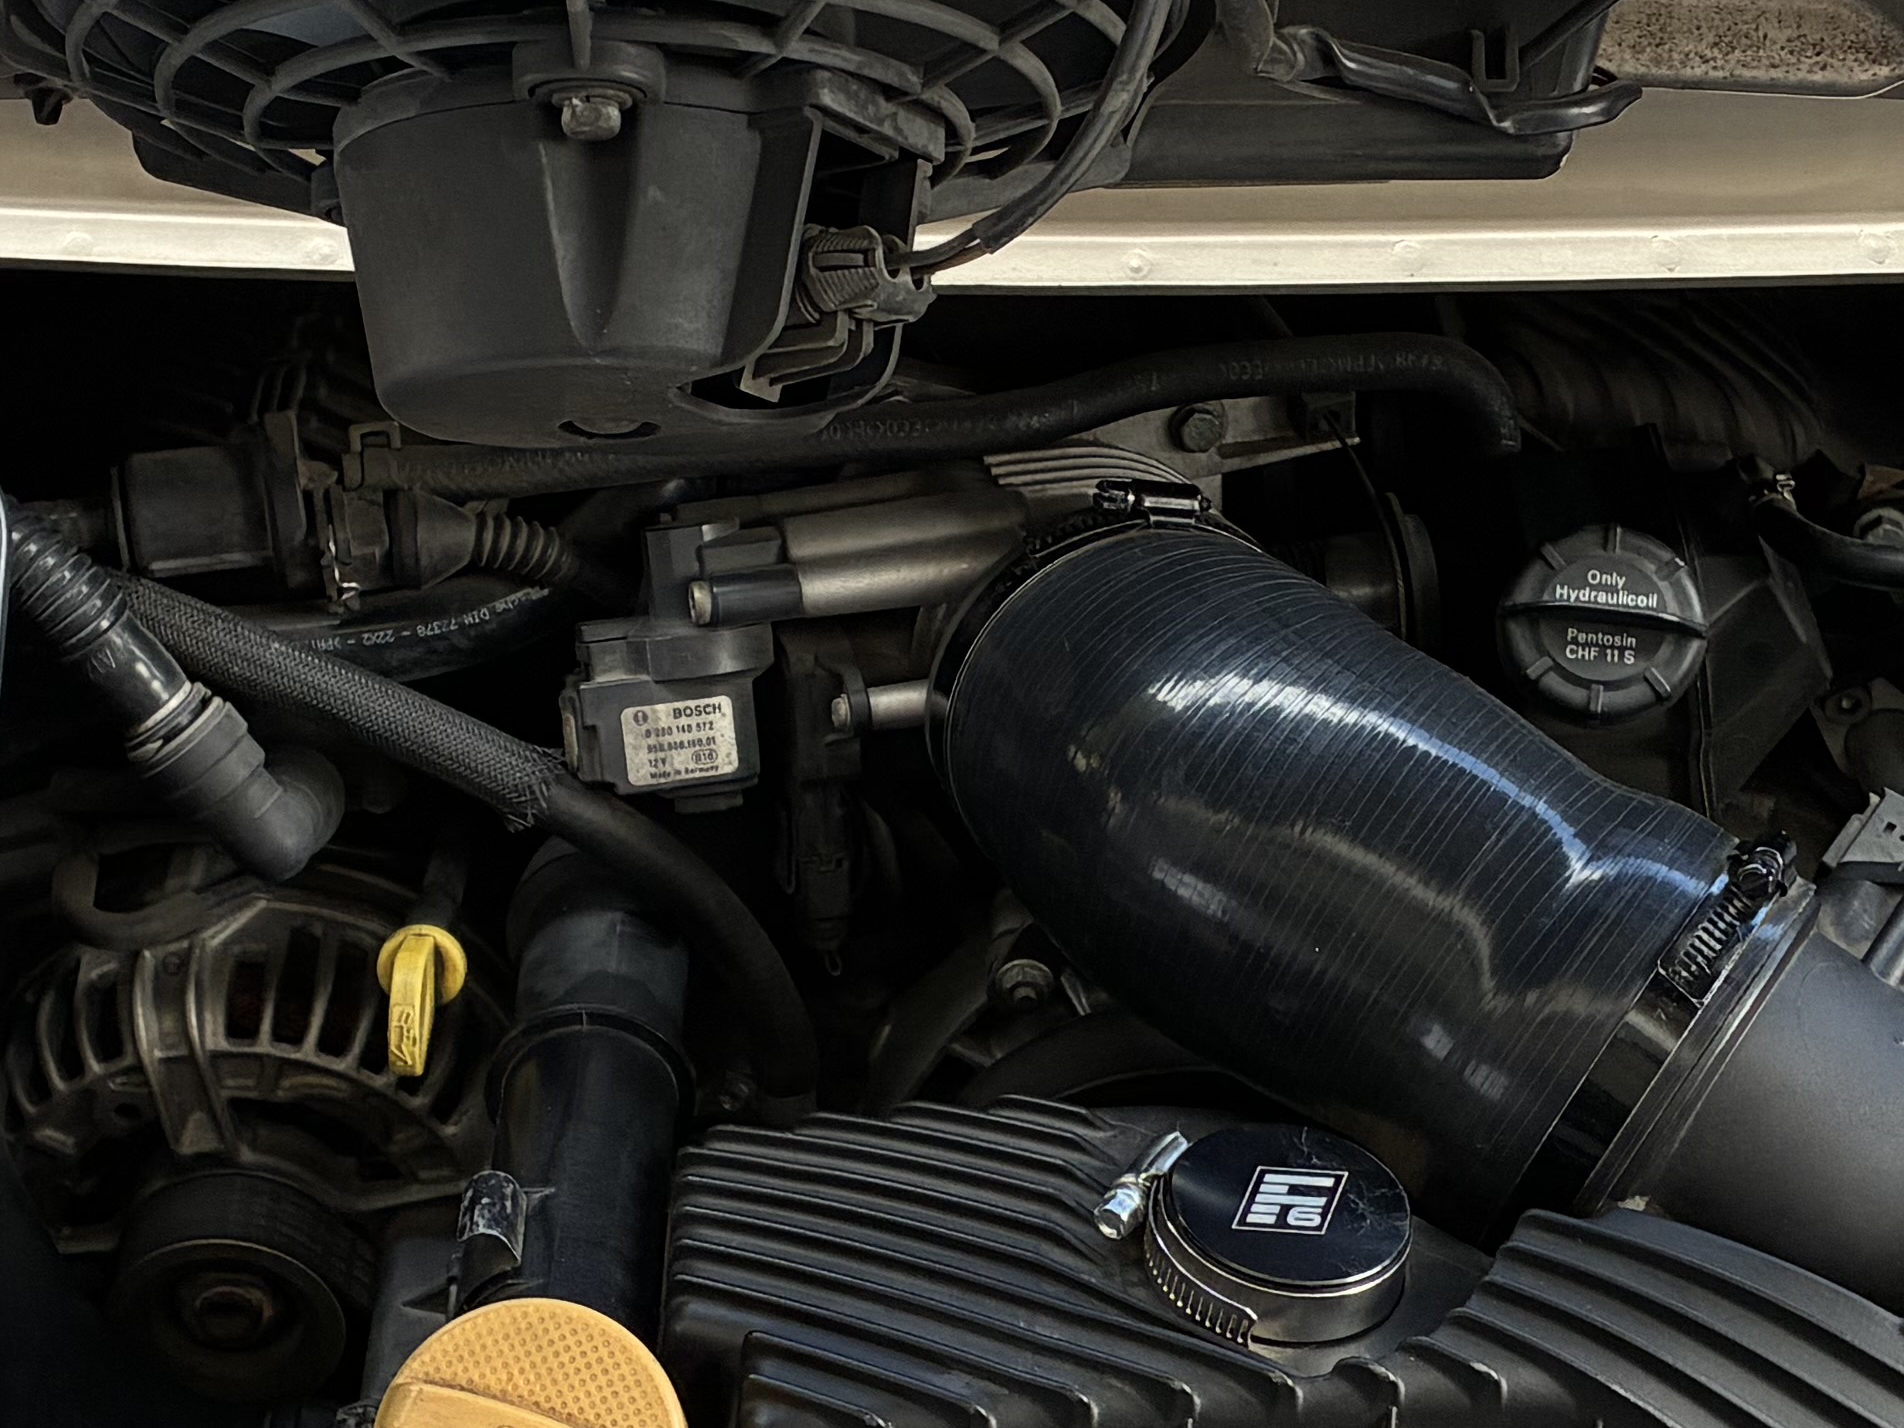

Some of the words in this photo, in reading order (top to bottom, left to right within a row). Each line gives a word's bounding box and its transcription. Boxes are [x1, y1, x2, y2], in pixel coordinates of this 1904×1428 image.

[1587, 569, 1626, 589] Only
[1555, 584, 1658, 608] Hydraulicoil
[1566, 627, 1637, 648] Pentosin
[1565, 645, 1600, 661] CHF
[1605, 647, 1619, 663] 11
[1624, 650, 1636, 665] S
[672, 702, 722, 720] BOSCH
